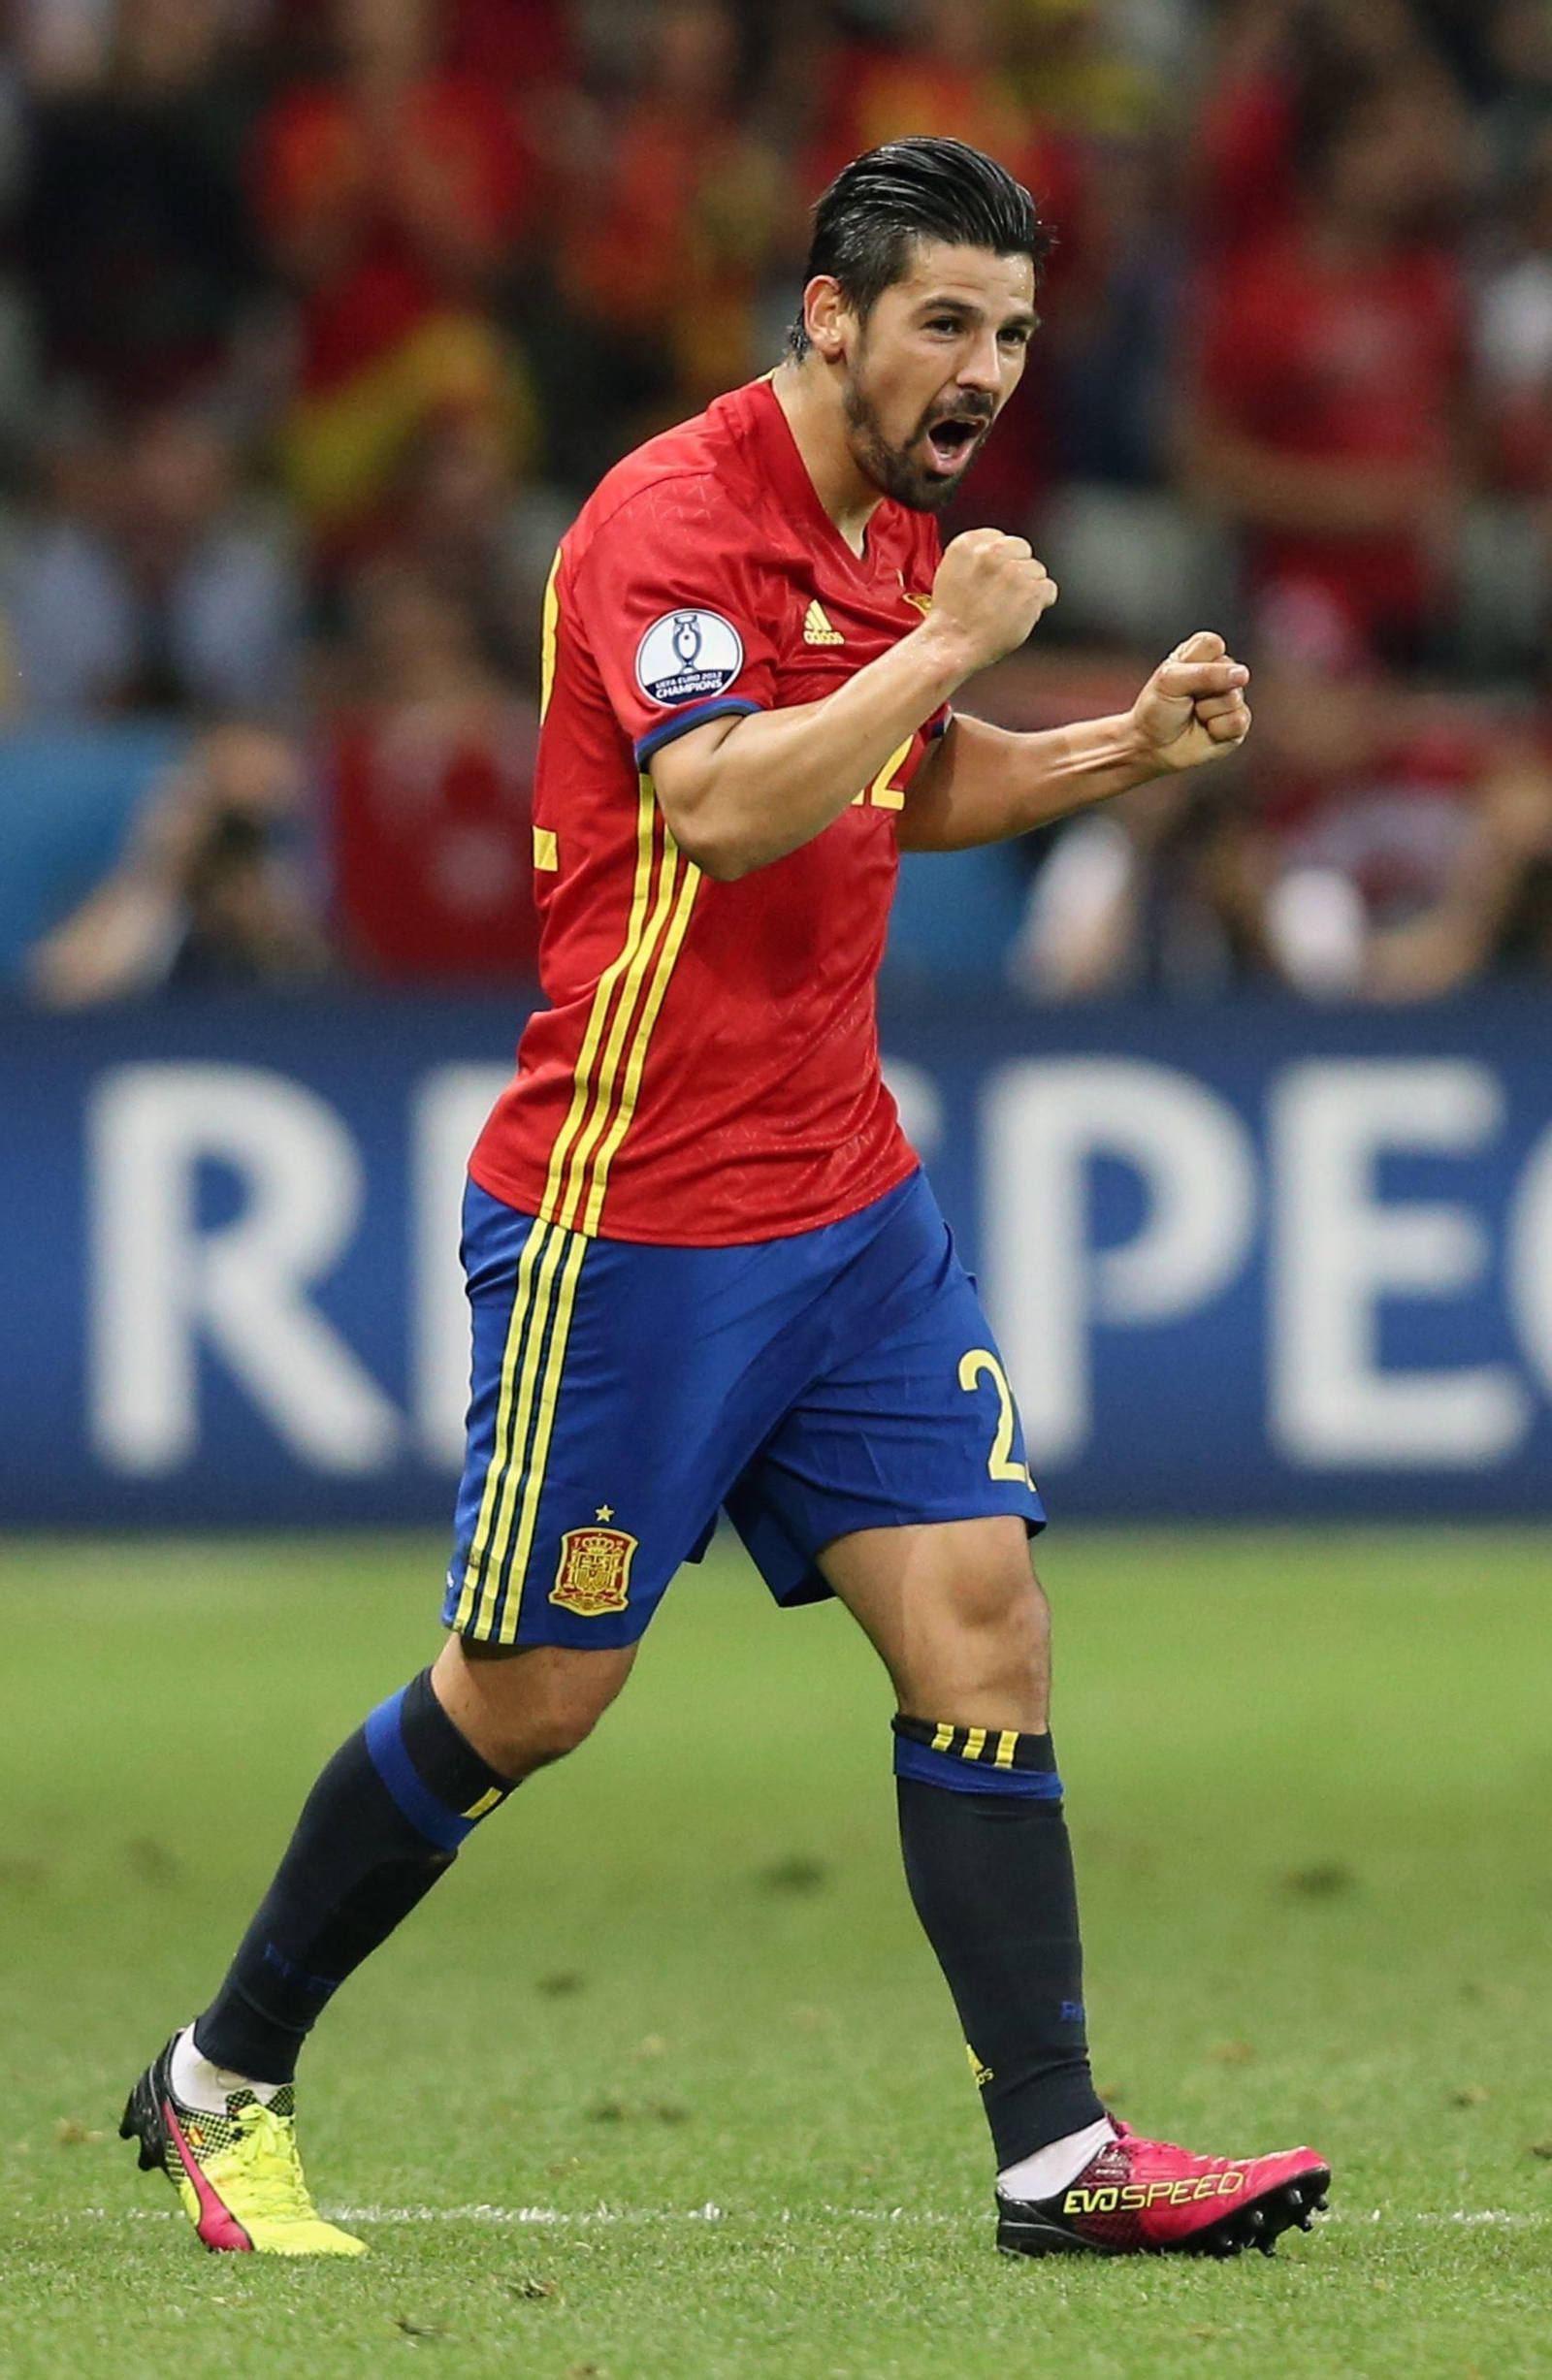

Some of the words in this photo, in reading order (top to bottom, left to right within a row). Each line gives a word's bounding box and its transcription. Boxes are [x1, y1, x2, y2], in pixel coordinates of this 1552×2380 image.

[803, 630, 845, 645] adidas
[655, 678, 677, 690] UEFA
[677, 673, 700, 685] EURO
[655, 679, 724, 698] CHAMPIONS
[851, 733, 905, 811] 2
[89, 1059, 1552, 1470] RPE
[958, 1348, 1037, 1494] 2
